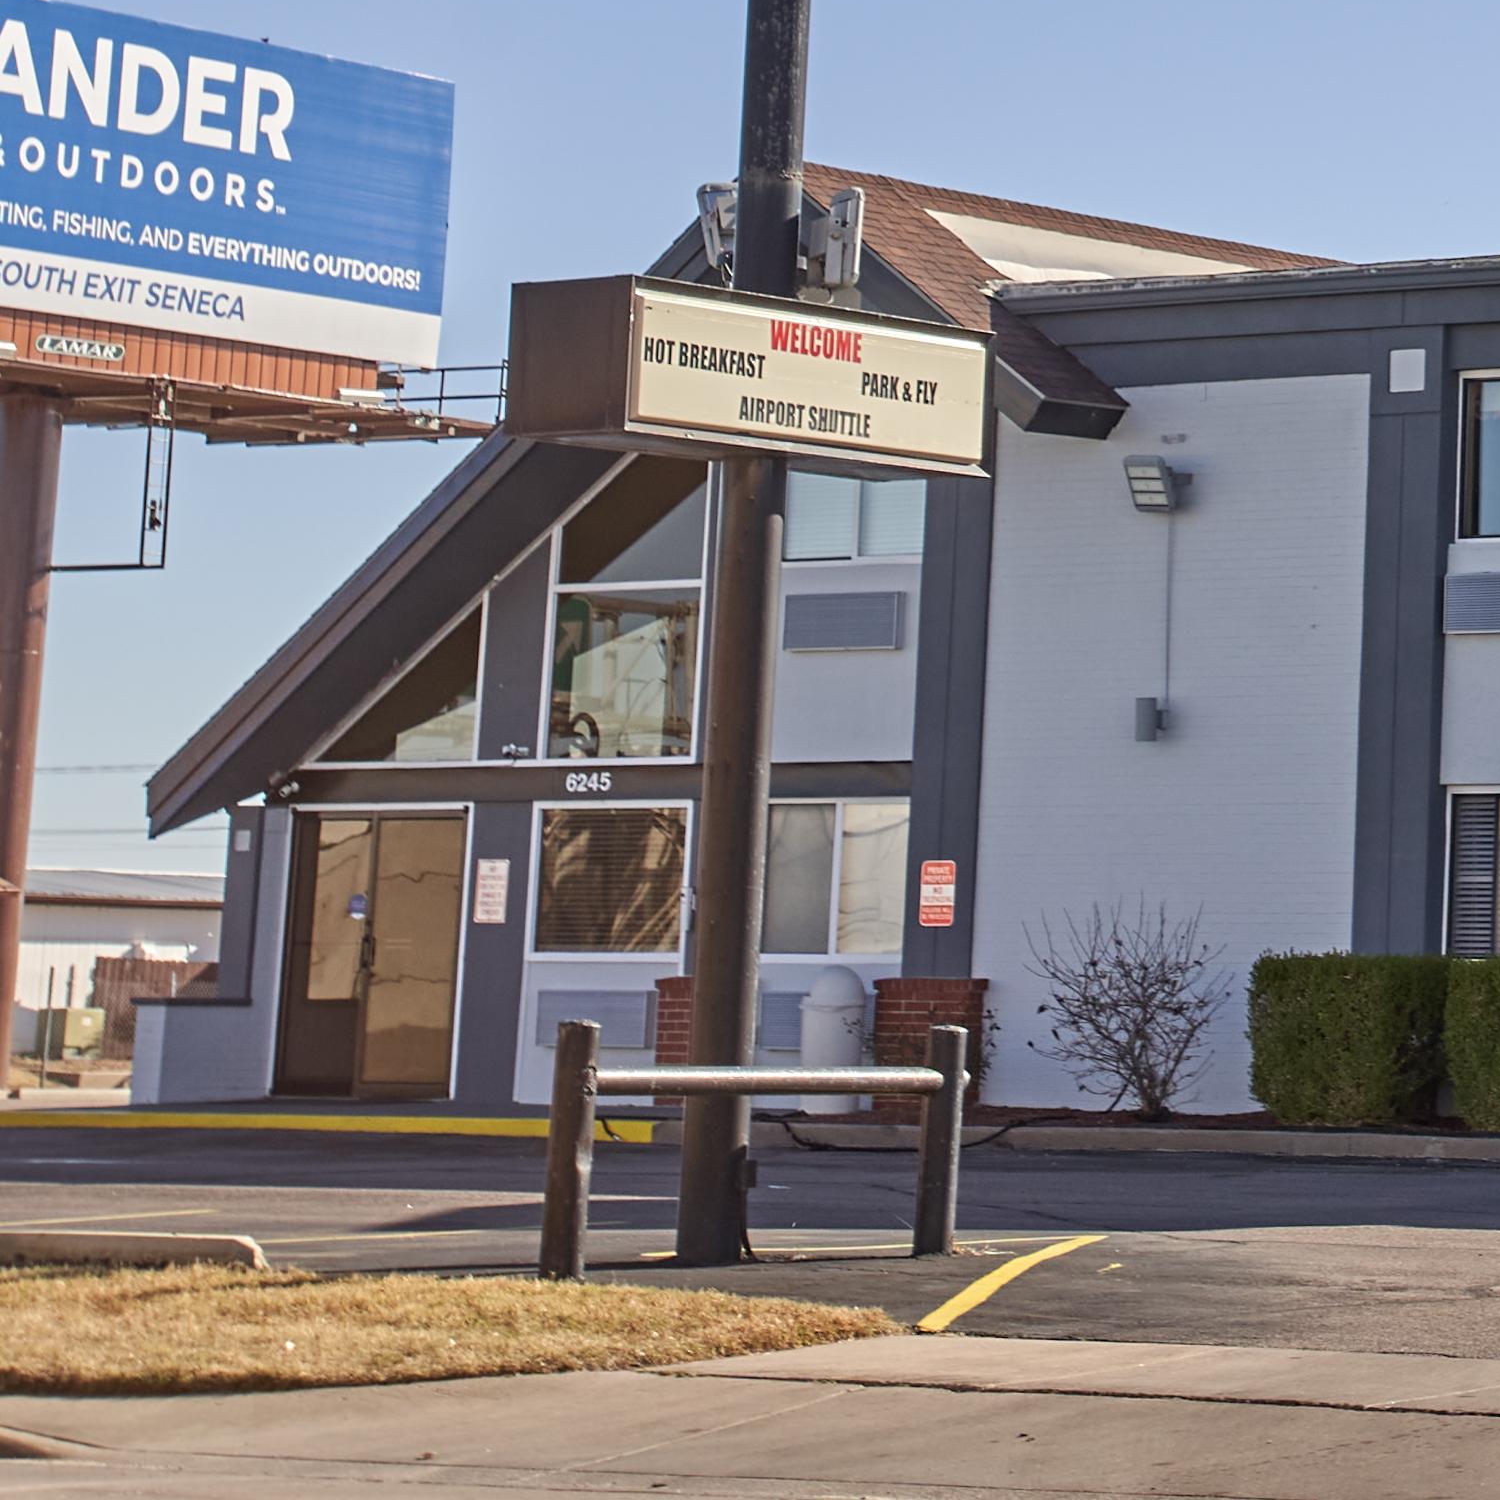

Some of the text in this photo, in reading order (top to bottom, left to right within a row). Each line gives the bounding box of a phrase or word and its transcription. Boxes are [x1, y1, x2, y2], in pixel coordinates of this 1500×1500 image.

[0, 19, 294, 162] ANDER
[52, 209, 134, 245] FISHING,
[139, 225, 183, 251] AND
[188, 232, 310, 273] EVERYTHING
[313, 253, 421, 292] OUTDOORS!
[0, 260, 245, 321] OUTH EXIT SENECA
[43, 337, 117, 359] LAMAR
[644, 336, 766, 379] HOT BREAKFAST
[770, 320, 862, 364] WELCOME
[861, 371, 938, 405] PARK & FLY
[739, 396, 871, 438] AIRPORT SHUTTLE
[565, 771, 612, 792] 6245
